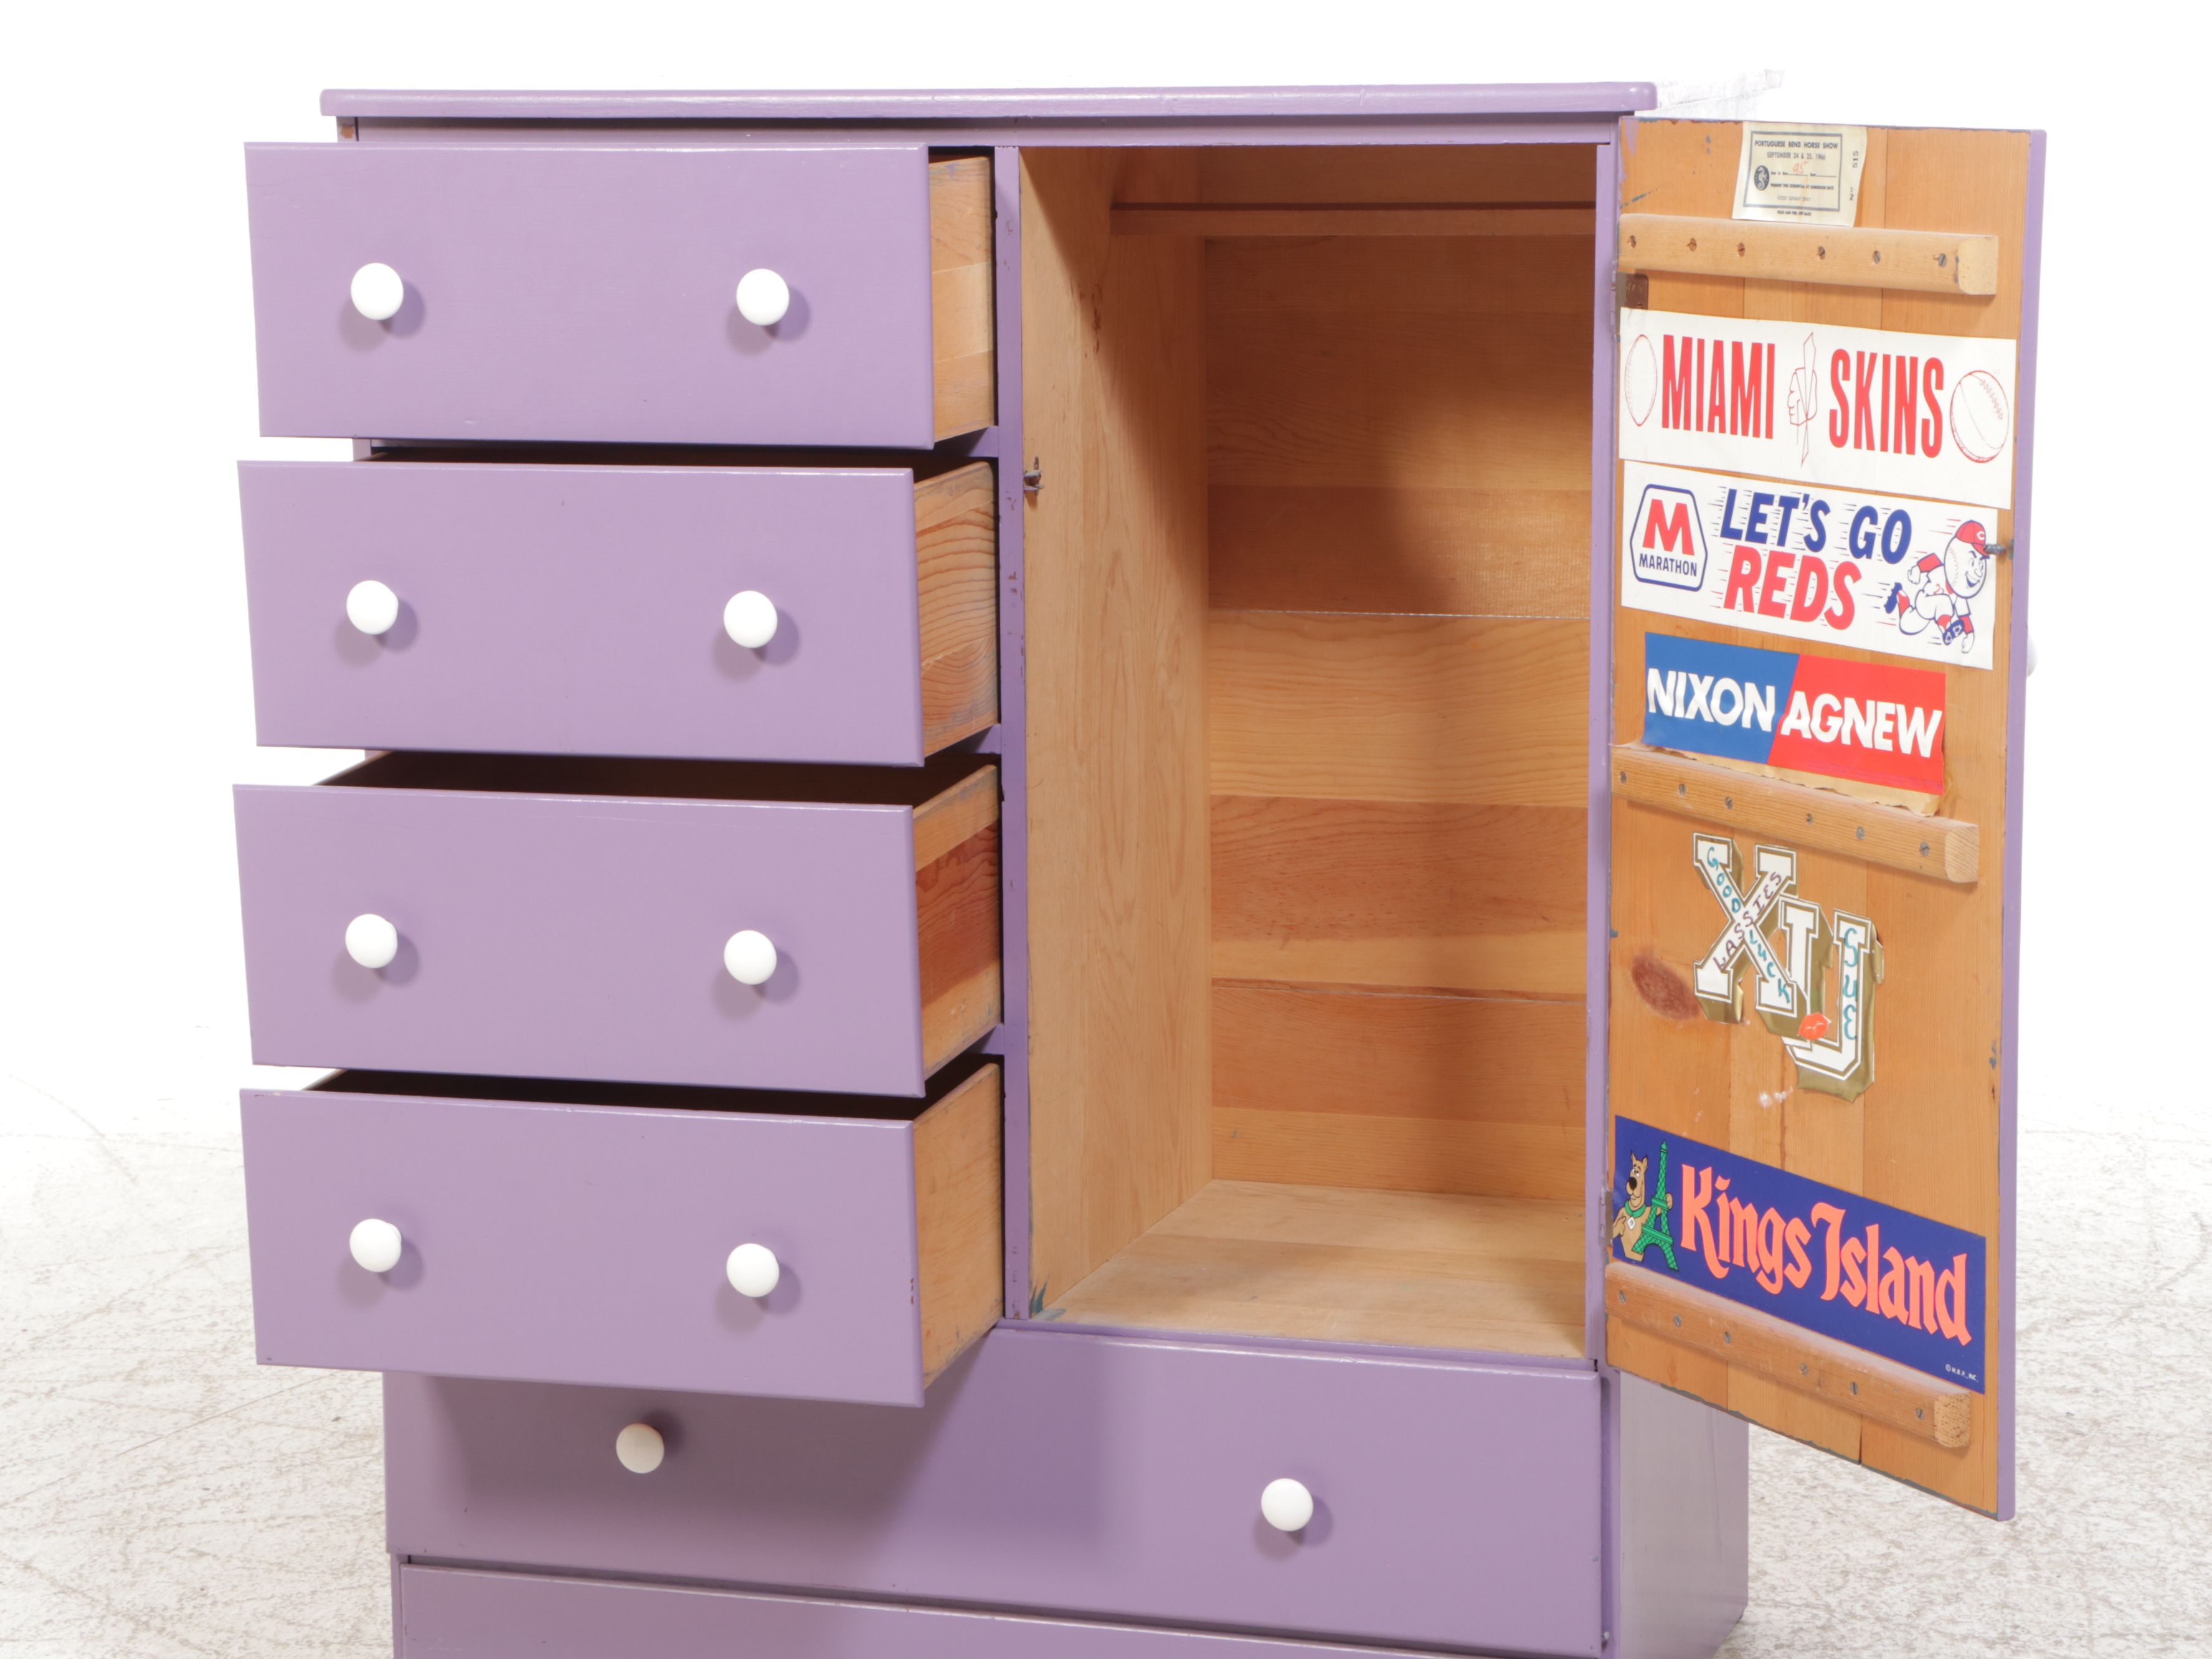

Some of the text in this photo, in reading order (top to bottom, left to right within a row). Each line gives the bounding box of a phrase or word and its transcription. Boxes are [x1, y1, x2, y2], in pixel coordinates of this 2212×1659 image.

[1662, 334, 1944, 458] MIAMI SKINS
[1638, 552, 1698, 577] MARATHON
[1642, 499, 1695, 555] M
[1719, 488, 1912, 564] LET'S GO
[1723, 544, 1862, 631] REDS
[1647, 668, 1943, 759] NIXON AGNEW
[1713, 871, 1783, 970] LASSIES
[1681, 1163, 1973, 1346] Kings Island
